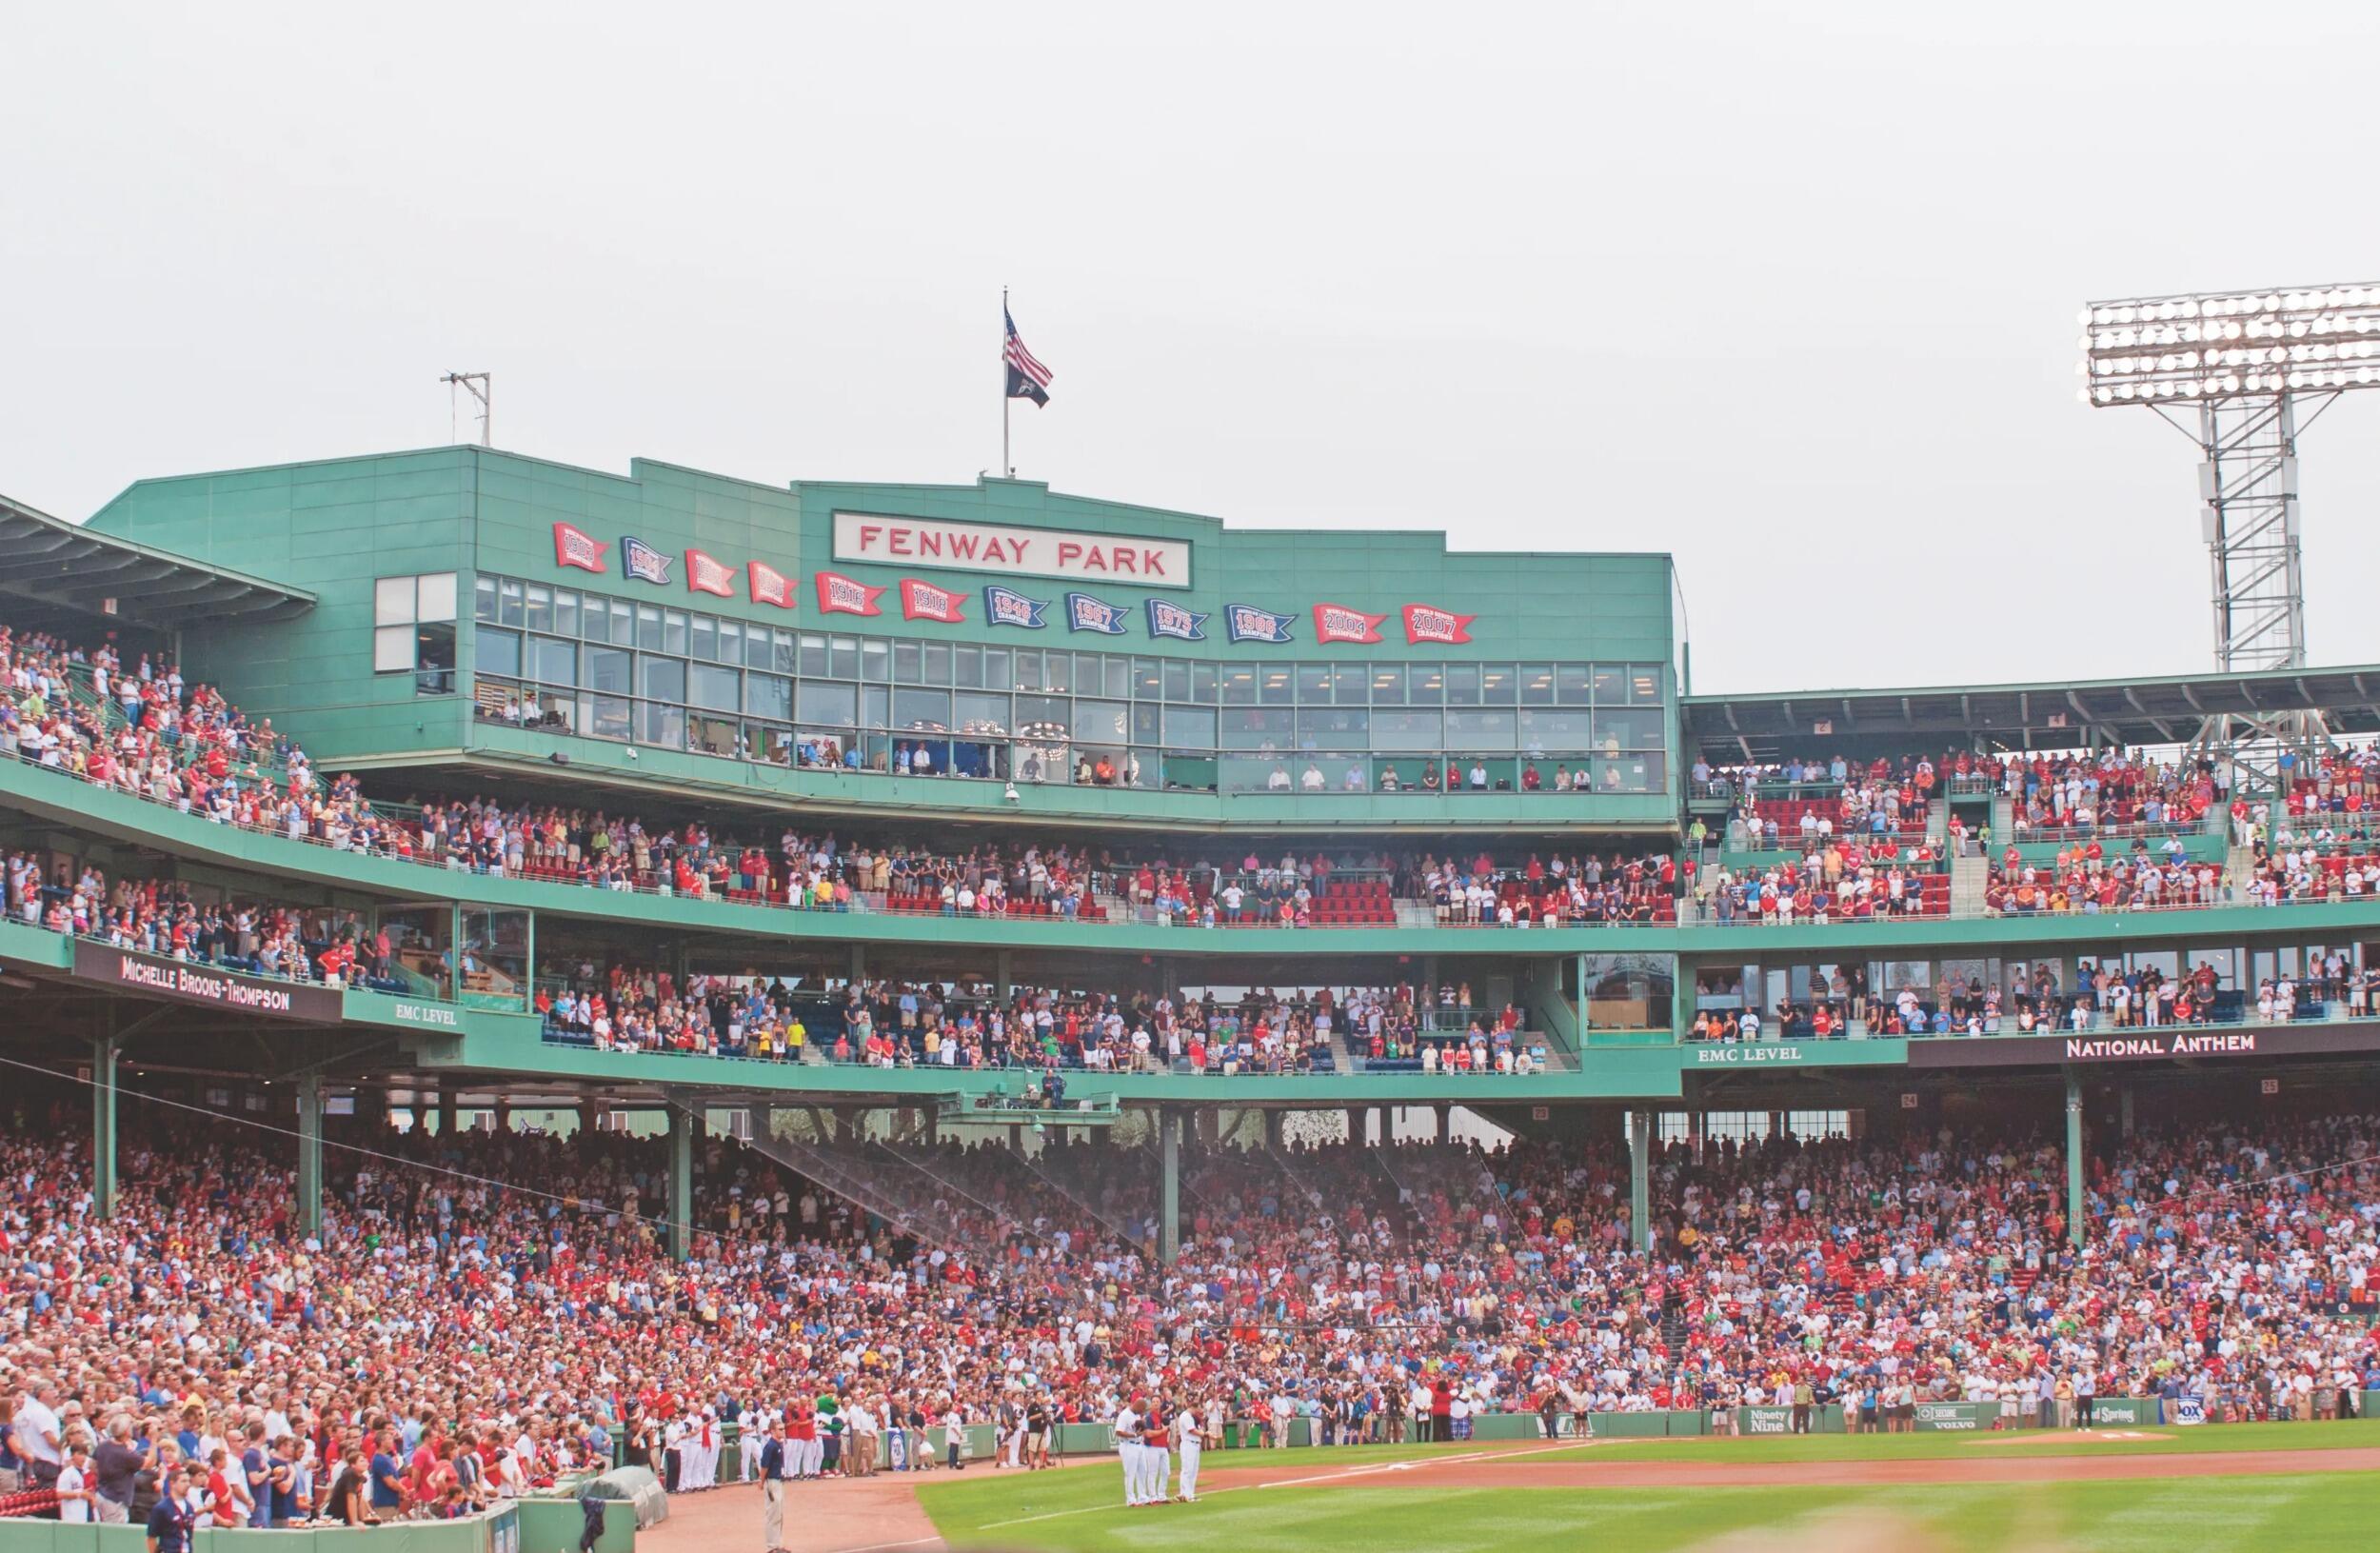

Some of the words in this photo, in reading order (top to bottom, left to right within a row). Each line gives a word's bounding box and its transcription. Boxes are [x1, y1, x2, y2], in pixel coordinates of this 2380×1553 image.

[860, 526, 1030, 564] FENWAY
[1058, 542, 1166, 576] PARK
[829, 582, 864, 606] 1916
[913, 588, 947, 611] 1918
[995, 597, 1032, 620] 1946
[1076, 602, 1113, 626] 1967
[1157, 607, 1193, 631] 1975
[1236, 613, 1277, 634] 1986
[1324, 614, 1366, 635] 2004
[1412, 614, 1456, 636] 2007
[122, 956, 177, 989] MICHELLE
[396, 1004, 421, 1021] EMC
[423, 1008, 457, 1025] LEVEL
[1697, 1048, 1738, 1062] EMC
[1743, 1047, 1802, 1061] LEVEL
[2066, 1039, 2166, 1058] NATIONAL
[2172, 1034, 2254, 1053] ANTHEM
[1751, 1410, 1786, 1421] Ninety
[2101, 1406, 2135, 1423] Spring
[2177, 1405, 2200, 1417] OX
[1751, 1420, 1785, 1432] Nine
